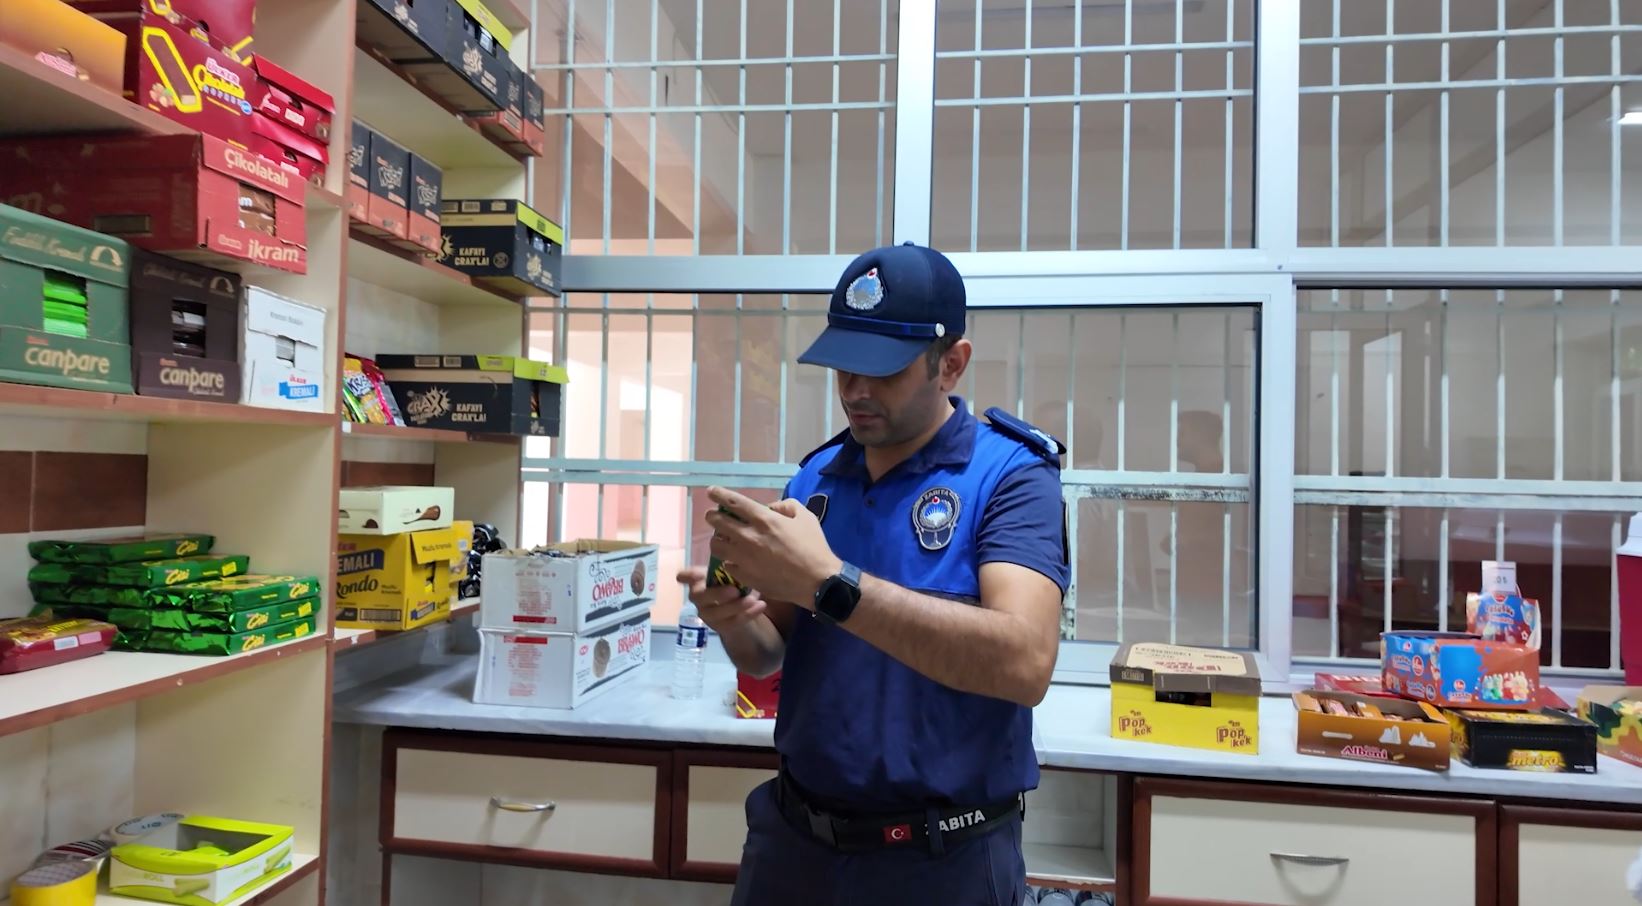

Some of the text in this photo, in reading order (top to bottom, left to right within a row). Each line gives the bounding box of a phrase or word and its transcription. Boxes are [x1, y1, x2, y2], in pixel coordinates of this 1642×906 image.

[224, 148, 289, 188] Çikolatalı
[248, 239, 299, 262] ikram
[25, 347, 110, 376] canpare
[160, 367, 225, 393] canpare
[337, 551, 375, 574] EMALI
[1340, 745, 1388, 760] Albeni
[1511, 752, 1560, 767] metro
[925, 809, 986, 836] ABITA
